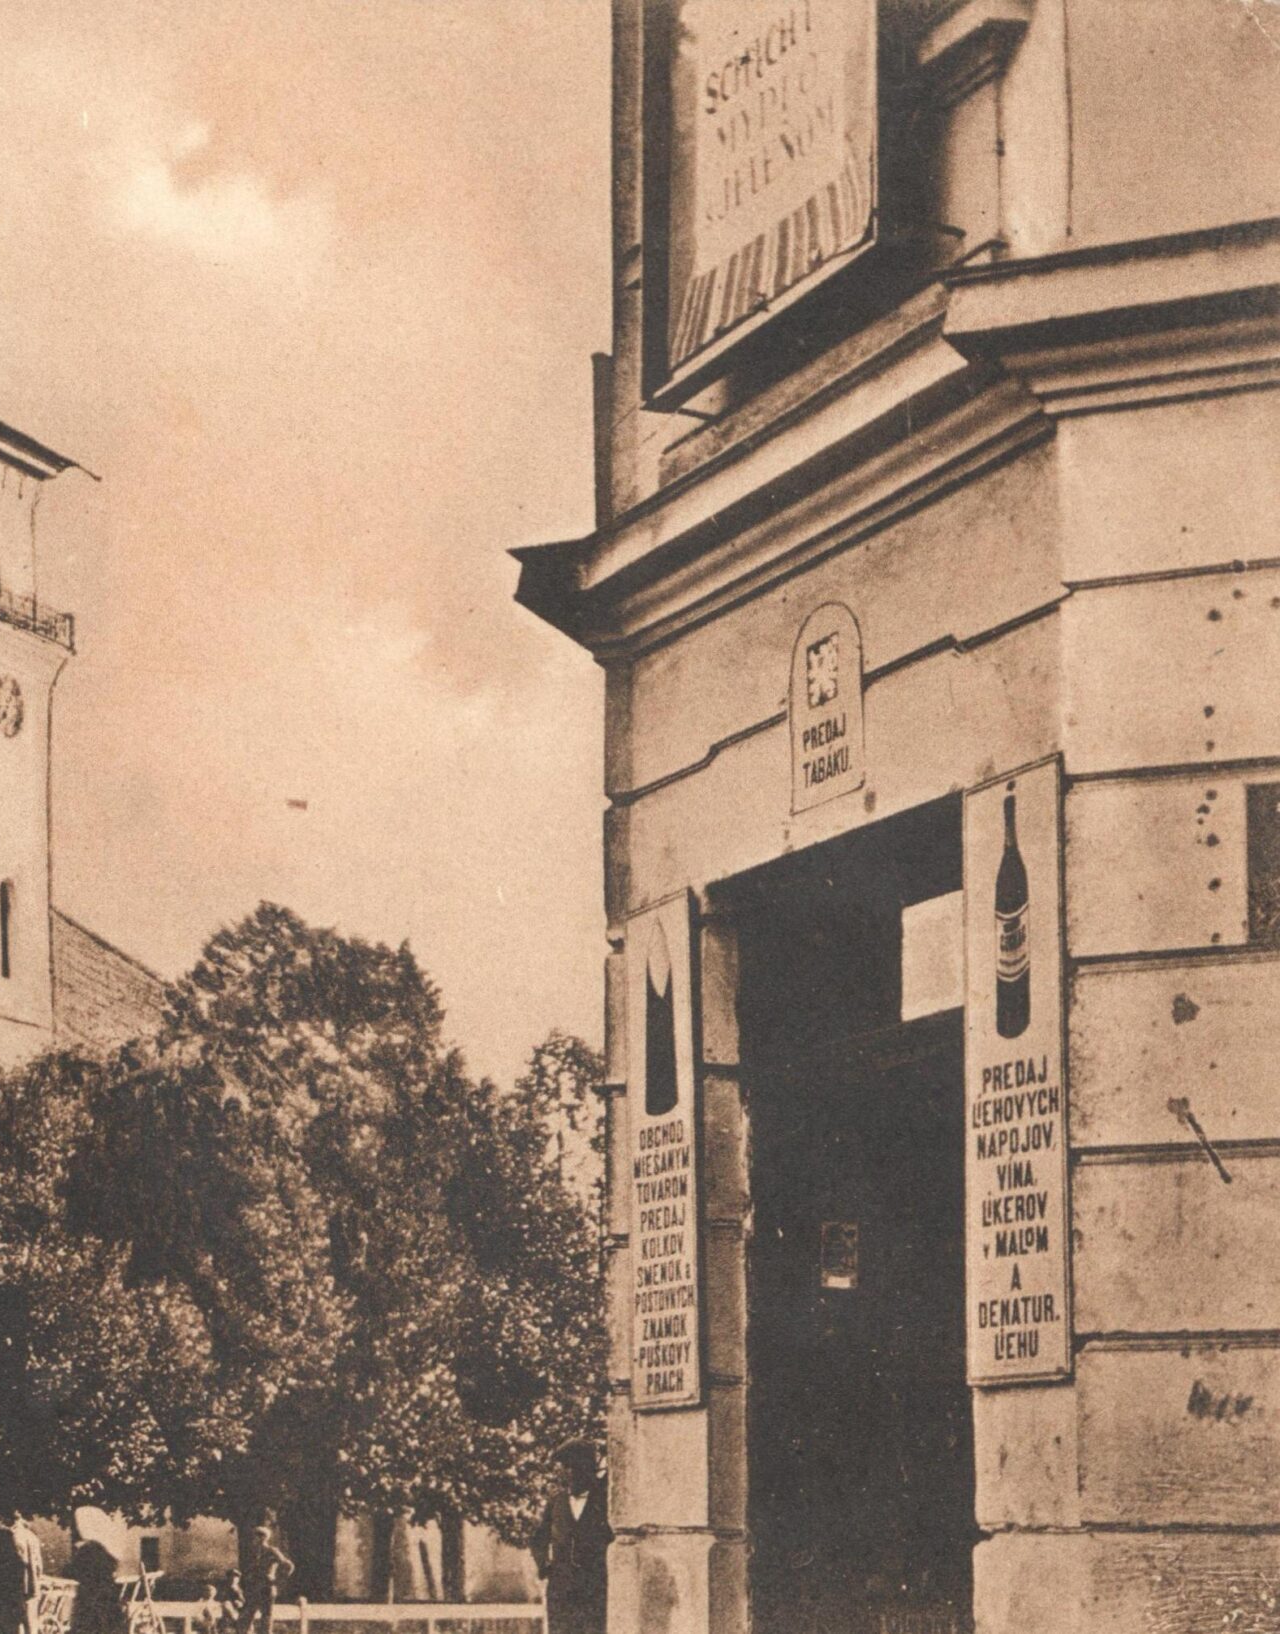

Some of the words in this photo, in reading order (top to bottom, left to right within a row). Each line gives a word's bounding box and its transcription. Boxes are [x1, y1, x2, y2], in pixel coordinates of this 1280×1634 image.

[802, 711, 846, 753] PREDAJ
[982, 1054, 1048, 1094] PREDAJ
[639, 1119, 684, 1151] OBCHOD
[636, 1174, 688, 1205] TOVAROM
[640, 1202, 686, 1234] PREDAJ
[995, 1225, 1048, 1258] MALOM
[636, 1258, 682, 1289] SMENOK
[1010, 1262, 1022, 1290] A
[978, 1294, 1061, 1329] DENATUR.
[646, 1367, 684, 1395] PRACH
